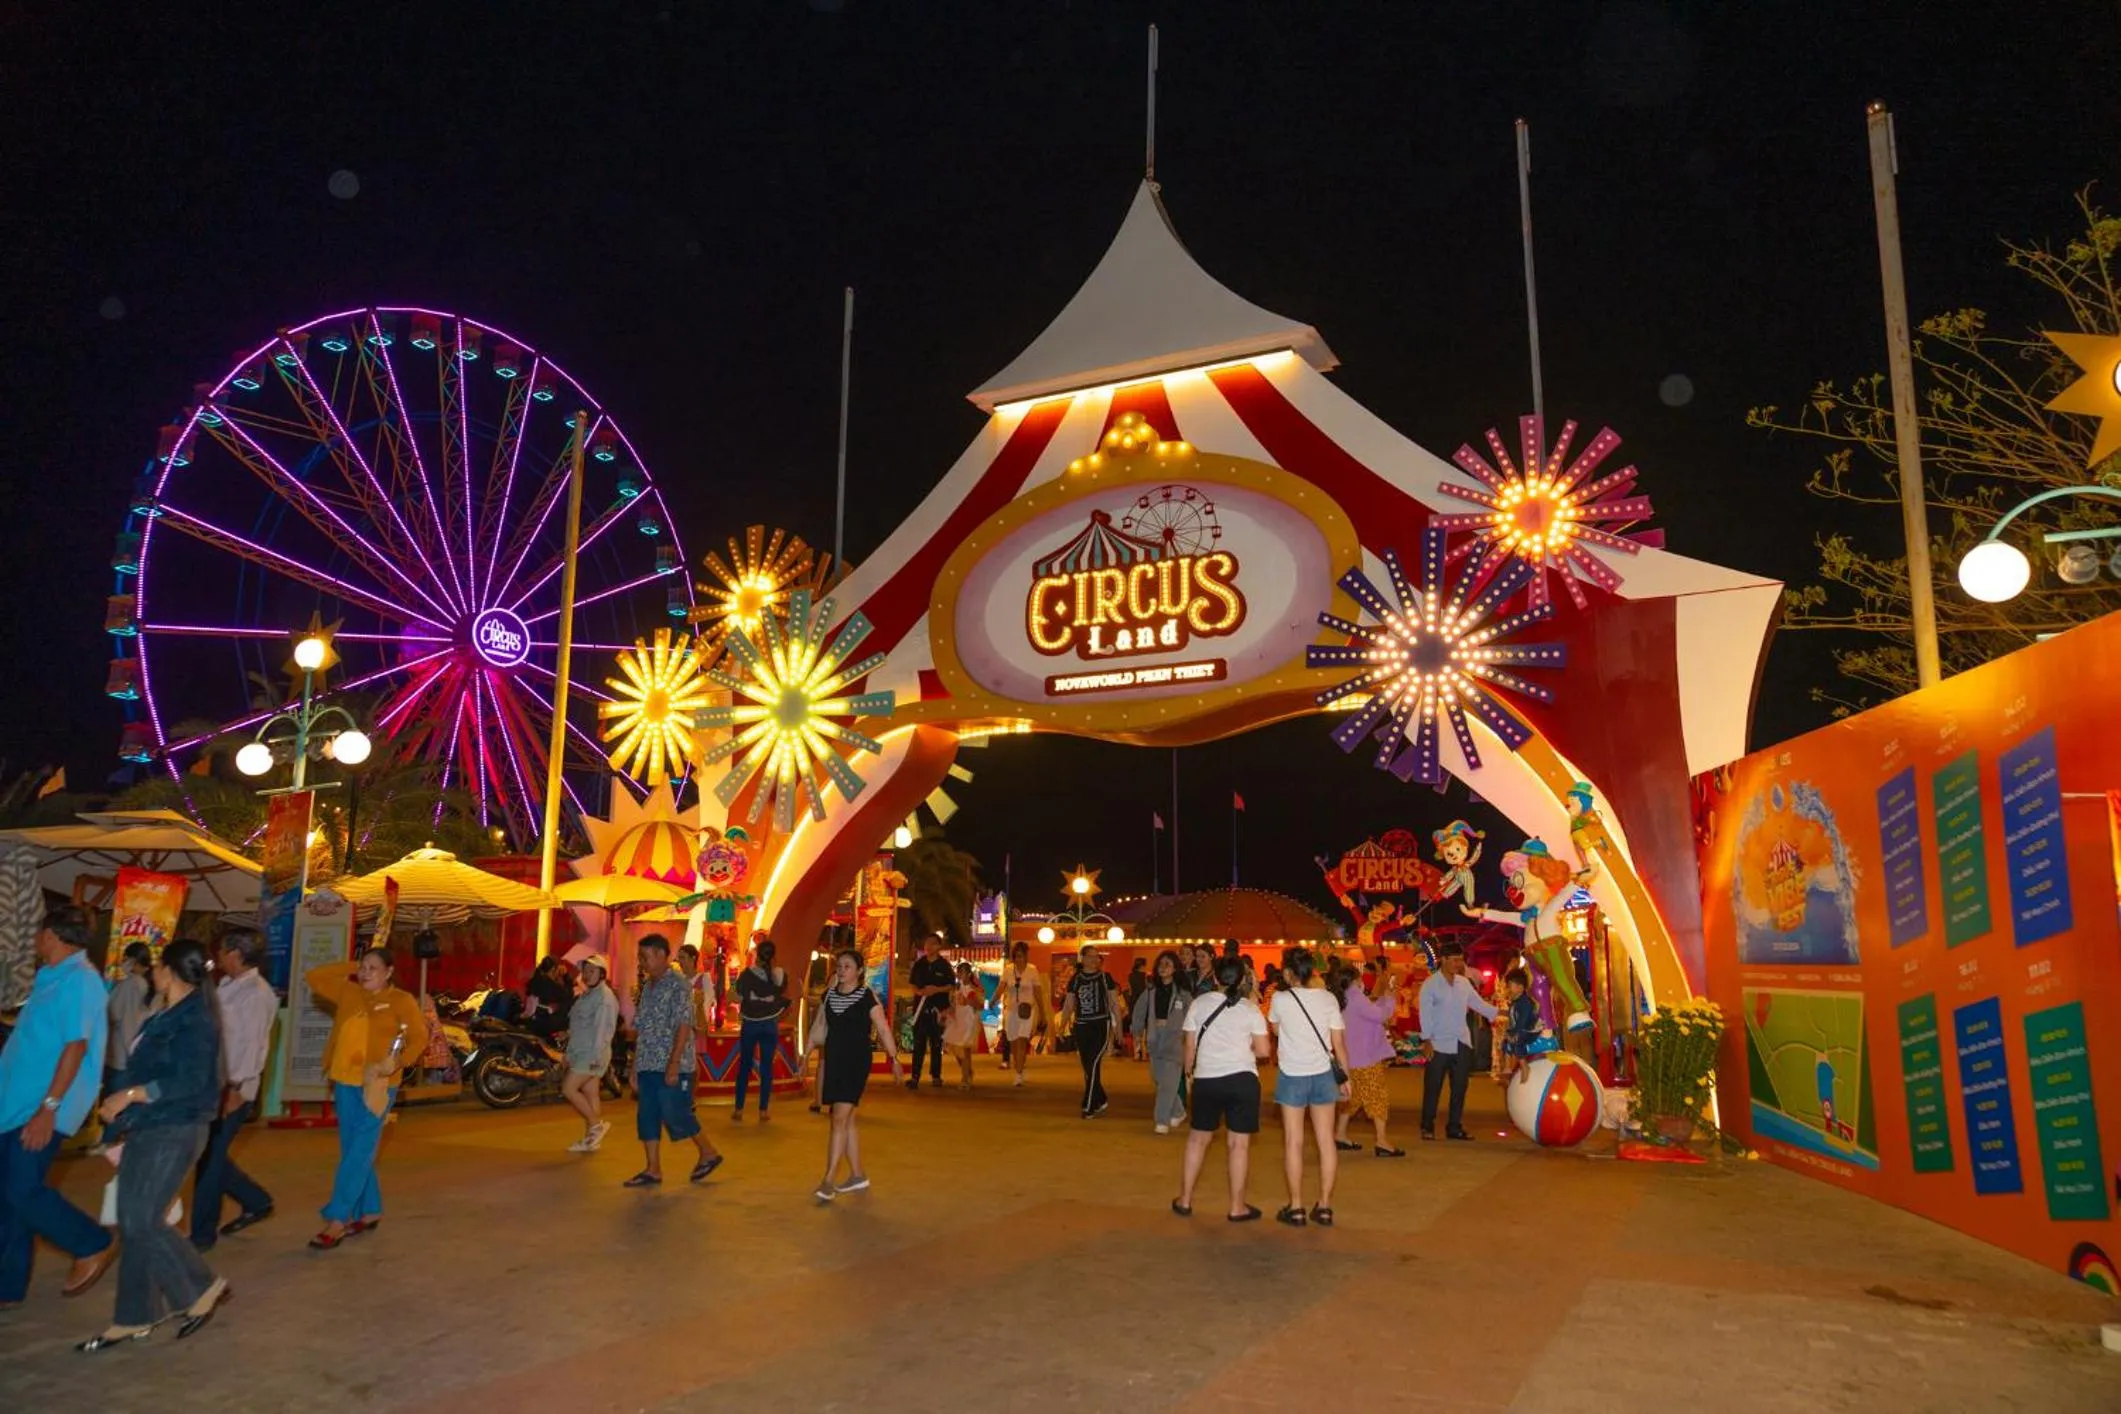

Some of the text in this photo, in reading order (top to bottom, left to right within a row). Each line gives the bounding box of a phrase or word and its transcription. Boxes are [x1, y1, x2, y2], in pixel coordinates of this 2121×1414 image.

[1030, 554, 1239, 650] CIRCUS
[1088, 619, 1179, 655] Land
[1054, 672, 1134, 691] NOVAWORLD
[1340, 857, 1424, 887] CIRCUS
[1363, 879, 1400, 891] Land
